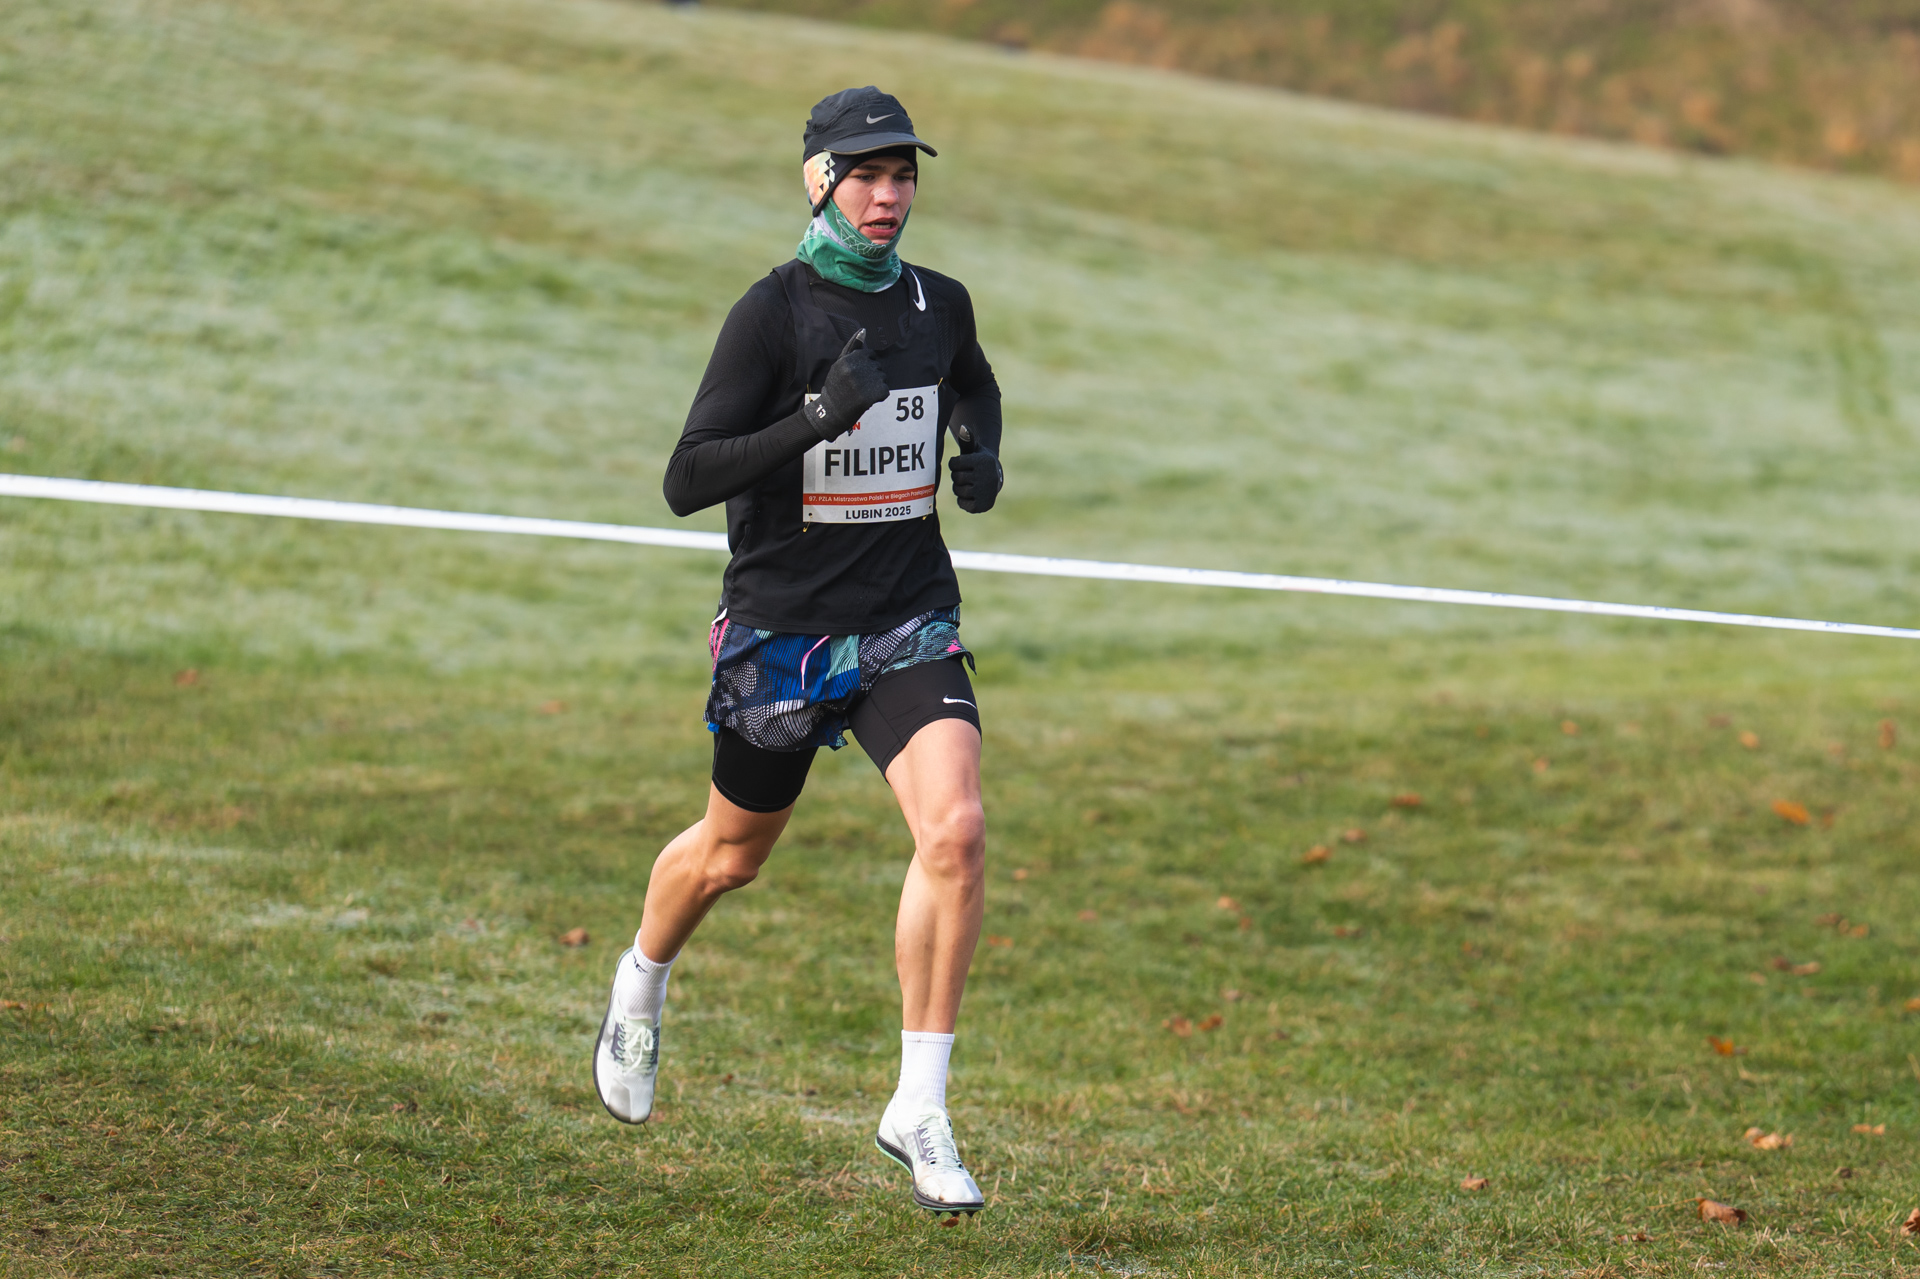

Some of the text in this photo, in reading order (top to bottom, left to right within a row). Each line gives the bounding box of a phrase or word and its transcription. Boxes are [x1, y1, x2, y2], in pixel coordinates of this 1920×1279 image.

[896, 395, 924, 423] 58
[825, 442, 926, 477] FILIPEK
[833, 495, 868, 503] Mistrzostwa
[845, 505, 912, 520] LUBIN 2025
